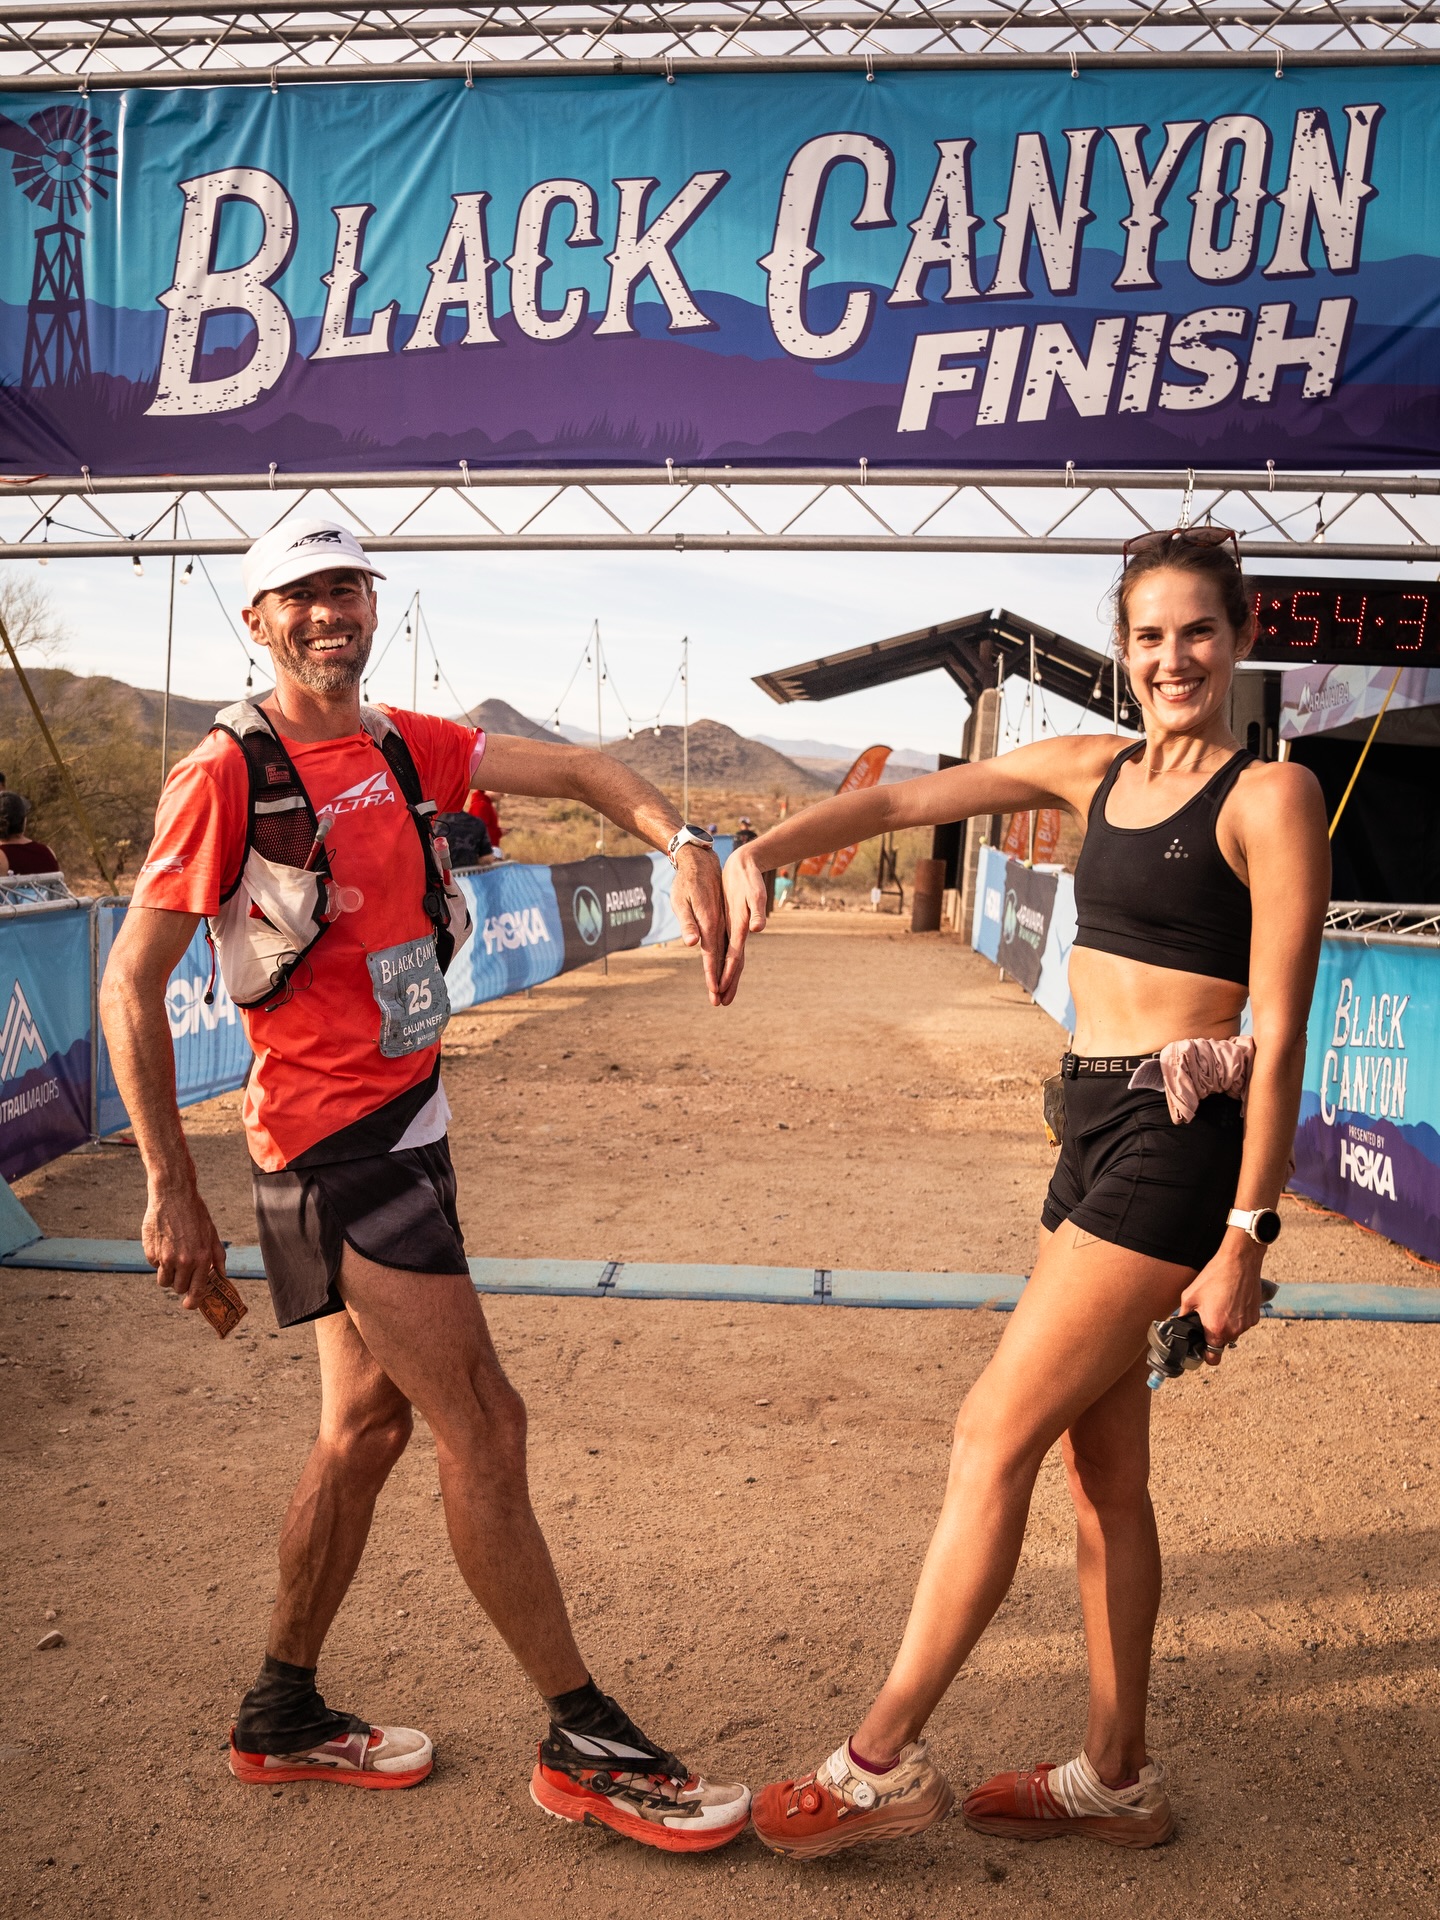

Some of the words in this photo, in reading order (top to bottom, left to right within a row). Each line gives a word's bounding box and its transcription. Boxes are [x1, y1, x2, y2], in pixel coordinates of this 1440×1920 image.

[143, 166, 730, 417] BLACK
[756, 103, 1386, 362] CANYON
[895, 297, 1358, 434] FINISH
[286, 537, 342, 552] ALTRA
[316, 790, 396, 817] ALTRA
[605, 886, 647, 913] ARAVAIPA
[609, 906, 646, 928] RUNNING
[482, 906, 551, 956] HOKA
[380, 952, 415, 985] BLACK
[164, 974, 236, 1039] OKA
[405, 978, 432, 1015] 25
[1331, 977, 1411, 1049] BLACK
[403, 1019, 426, 1037] CALUM
[426, 1013, 443, 1028] NEFF
[1320, 1049, 1408, 1126] CANYON
[1348, 1124, 1376, 1147] PRESENTED
[1376, 1135, 1385, 1149] BY
[1340, 1139, 1397, 1201] HOKA
